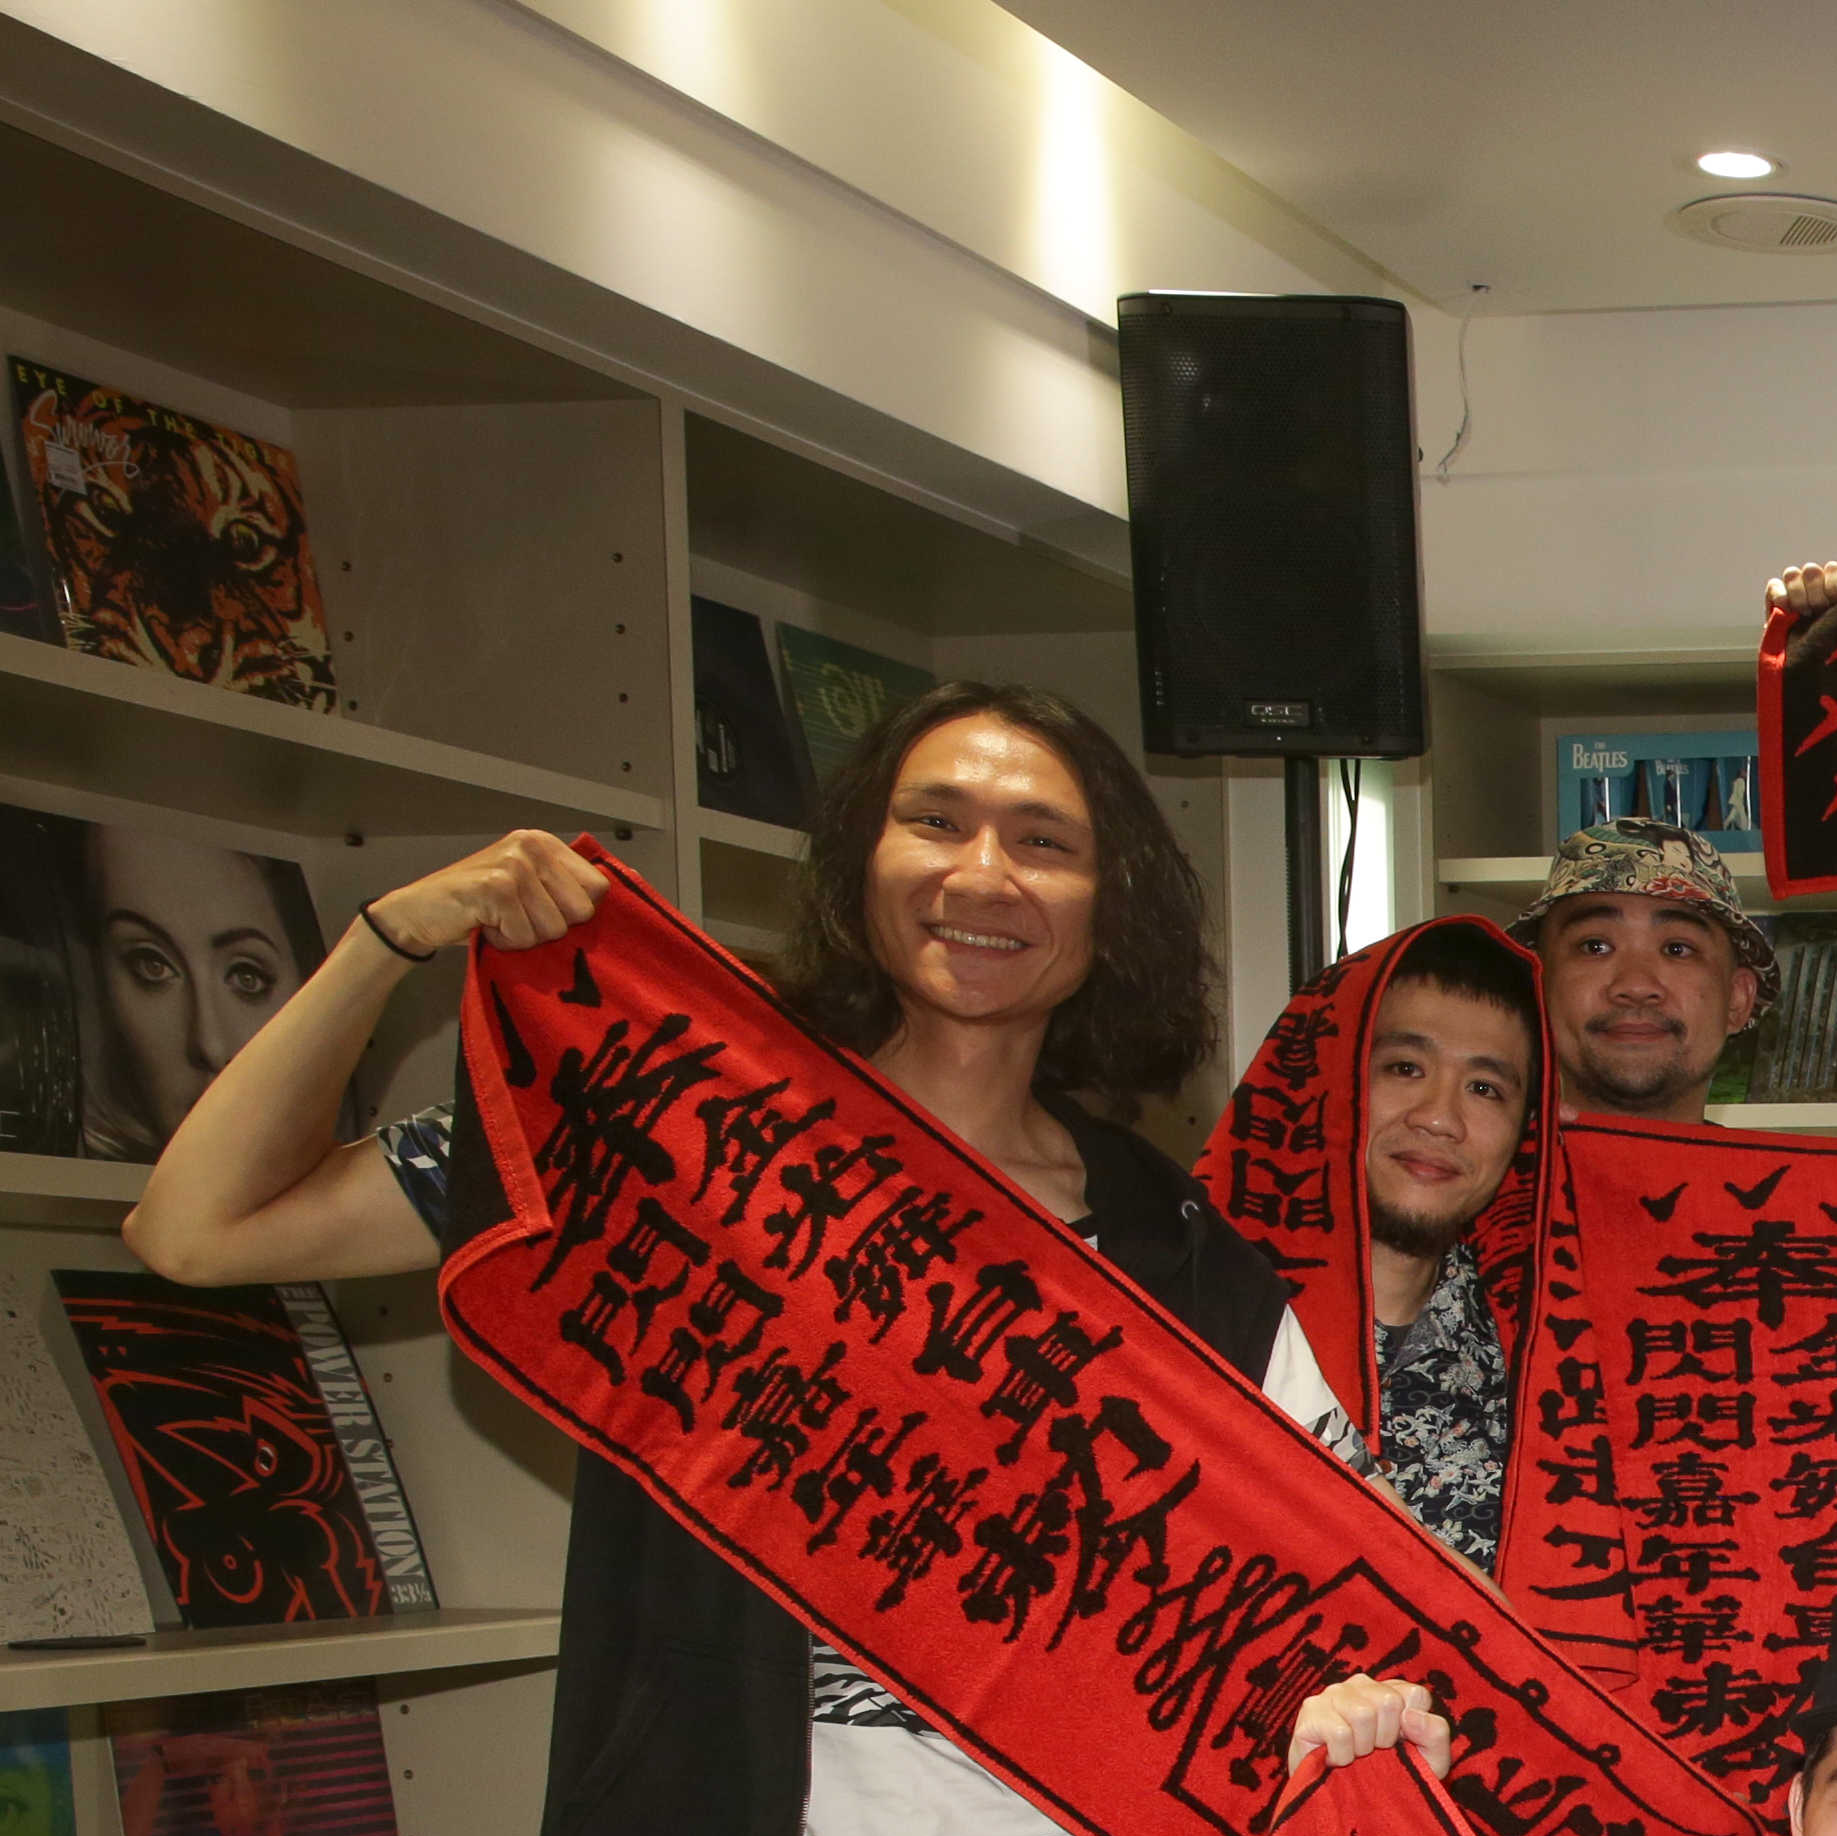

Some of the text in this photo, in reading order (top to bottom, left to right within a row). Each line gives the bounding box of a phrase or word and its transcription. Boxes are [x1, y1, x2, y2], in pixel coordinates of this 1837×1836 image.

[17, 365, 290, 470] EYE OF THE TIGER
[286, 1298, 426, 1578] POWER STATION
[1621, 1317, 1761, 1663] 閃閃嘉年華
